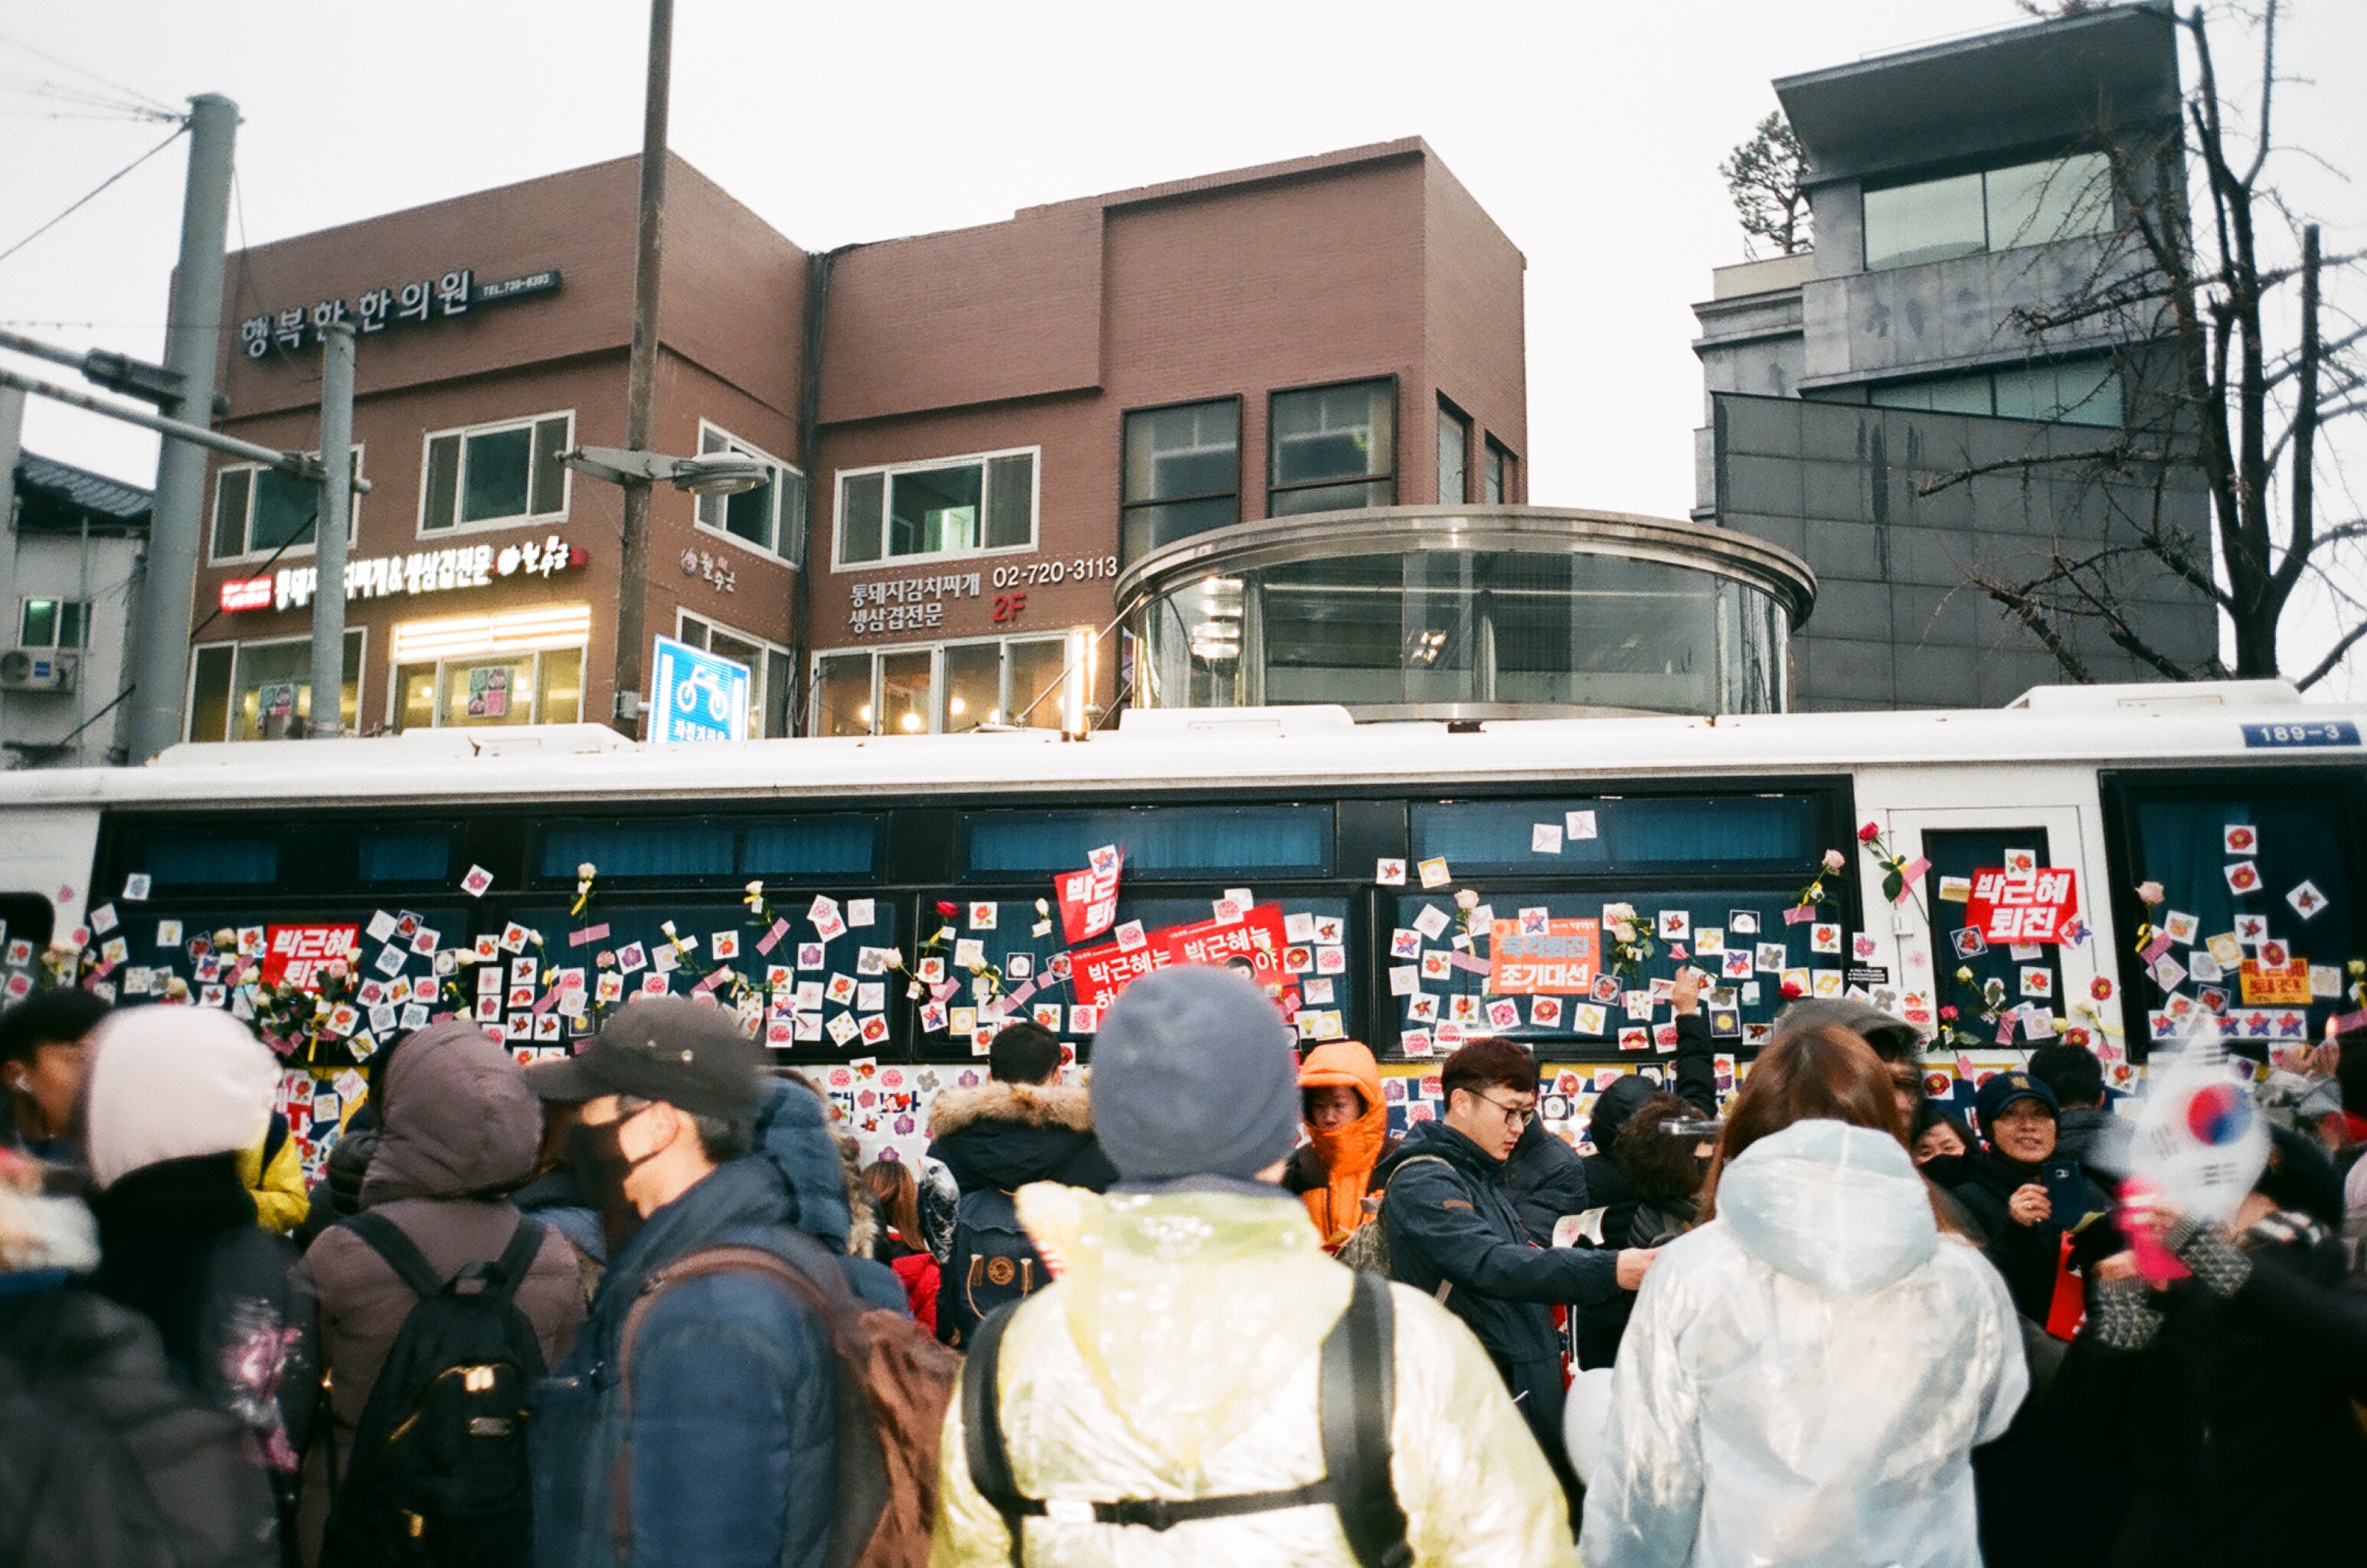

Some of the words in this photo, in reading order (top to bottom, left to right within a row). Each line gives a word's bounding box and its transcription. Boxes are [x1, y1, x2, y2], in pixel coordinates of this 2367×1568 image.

[992, 556, 1118, 589] 02-720-3113
[850, 572, 981, 608] 통돼지김치찌개
[848, 602, 943, 634] 생삼겹전문
[992, 593, 1025, 622] 2F
[2261, 724, 2340, 742] 189-3
[1973, 872, 2071, 904] 박근혜
[1084, 897, 1116, 934] 퇴
[1987, 906, 2057, 938] 퇴진
[272, 928, 355, 958] 박근혜
[1087, 948, 1173, 985] 박근혜는
[1499, 963, 1590, 987] 조기대선
